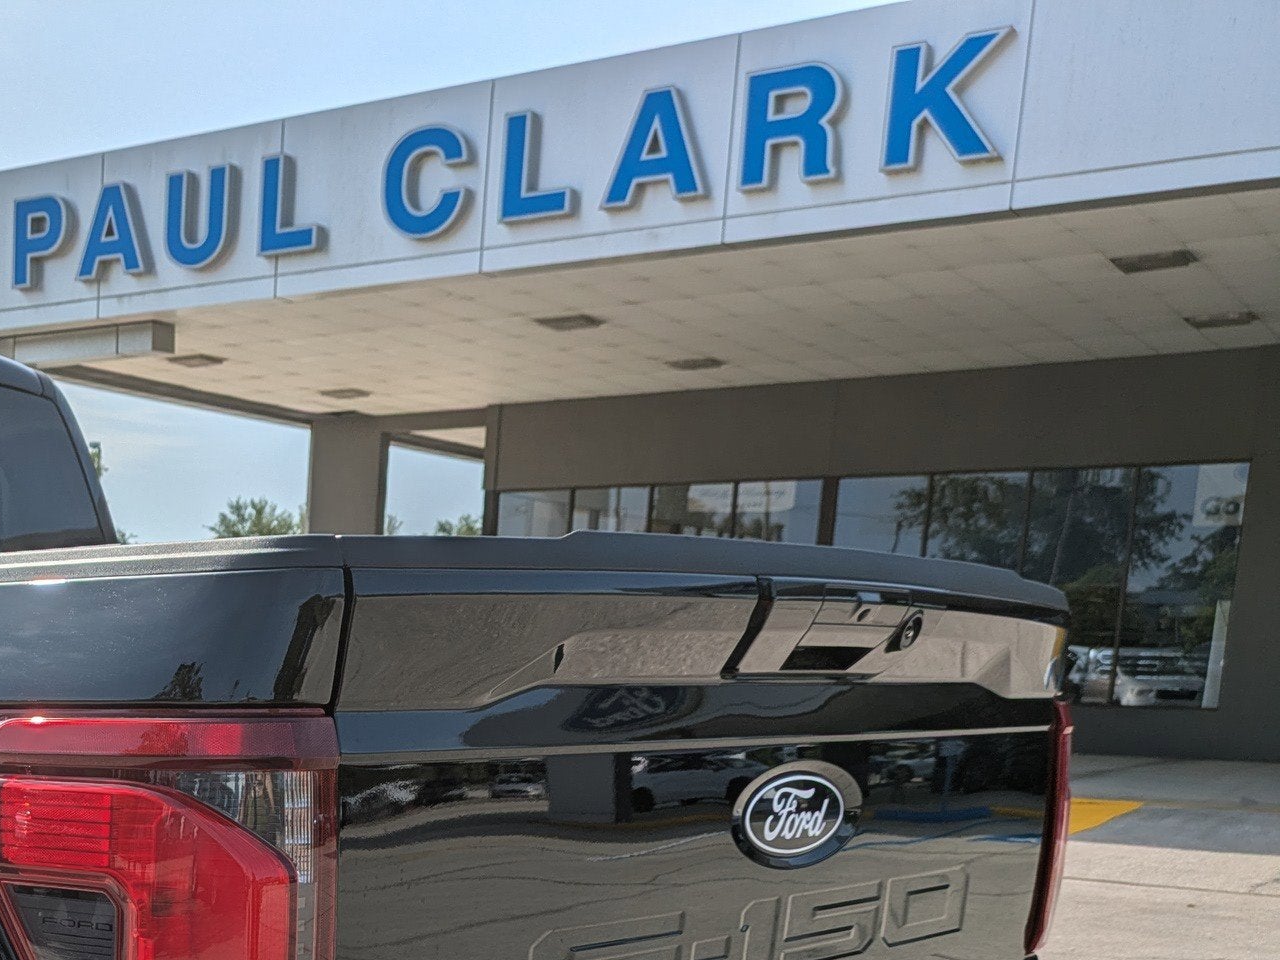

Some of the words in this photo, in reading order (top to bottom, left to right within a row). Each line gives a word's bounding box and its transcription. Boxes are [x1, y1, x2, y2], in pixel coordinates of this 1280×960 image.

[12, 154, 322, 290] PAUL
[381, 24, 1016, 240] CLARK
[763, 786, 829, 842] Ford
[41, 915, 114, 932] FORD
